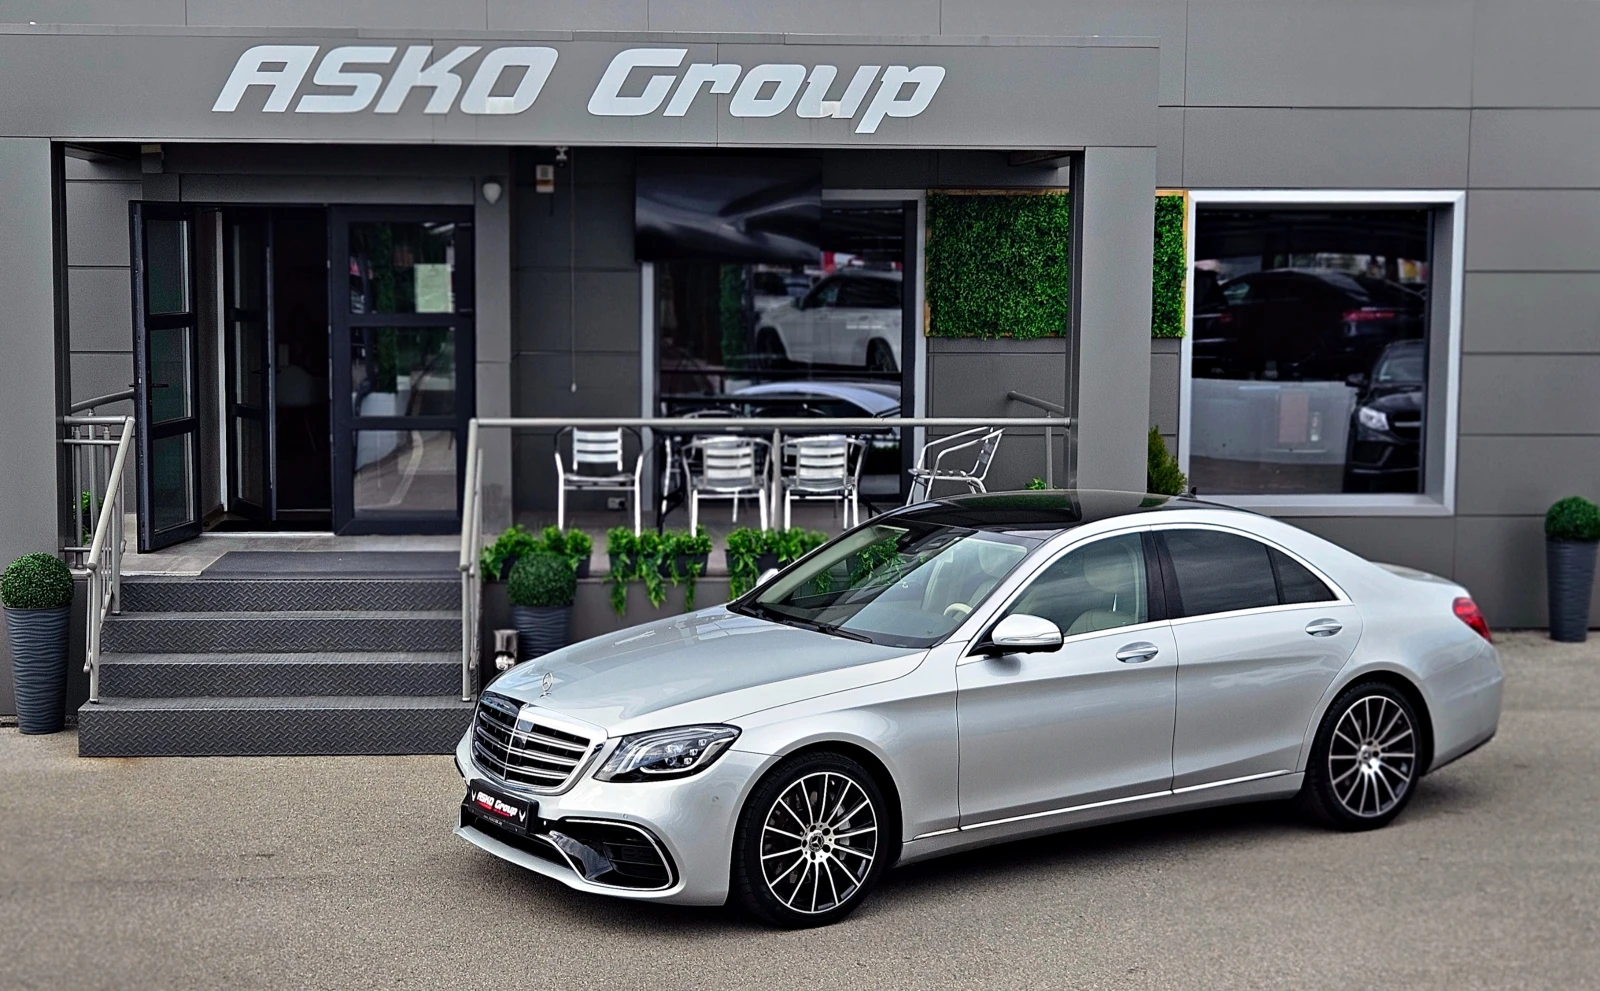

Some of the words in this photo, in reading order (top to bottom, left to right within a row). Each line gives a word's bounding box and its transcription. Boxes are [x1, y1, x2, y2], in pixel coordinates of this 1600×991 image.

[211, 45, 559, 114] ASKO
[587, 48, 946, 134] Group
[476, 791, 495, 807] ASKO
[494, 799, 518, 817] Group
